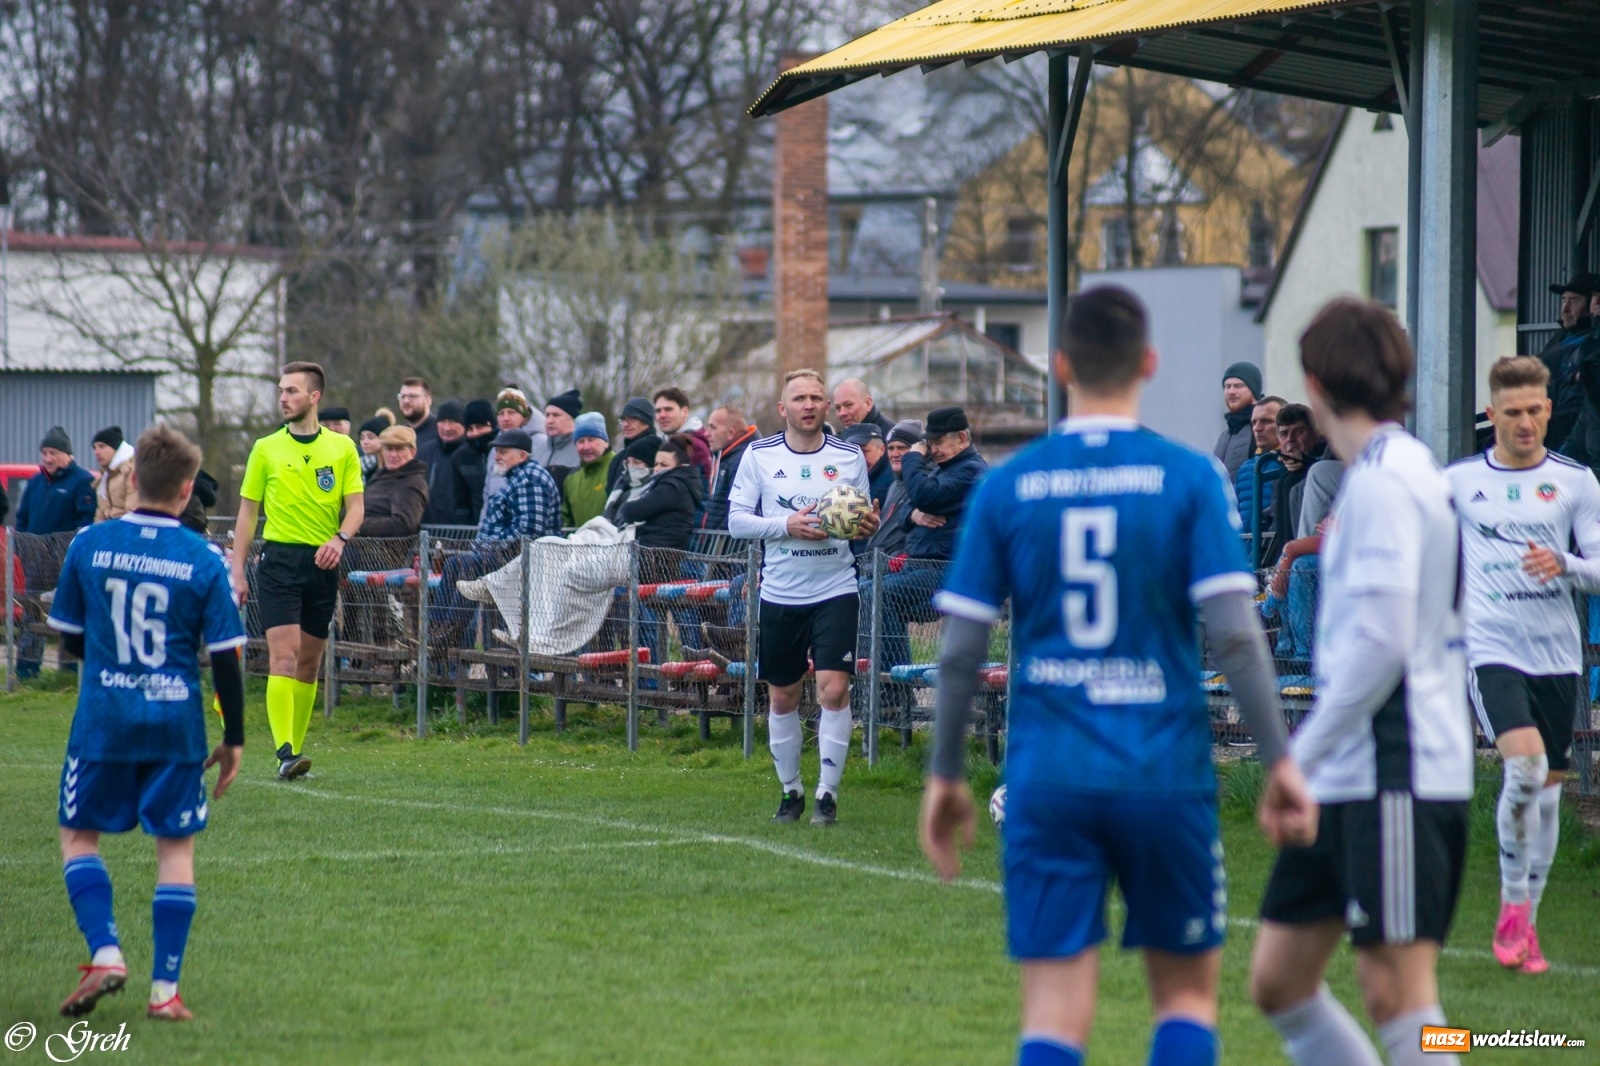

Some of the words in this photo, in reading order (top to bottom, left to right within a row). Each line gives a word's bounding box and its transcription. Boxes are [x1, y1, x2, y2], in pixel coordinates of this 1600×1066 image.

[92, 549, 113, 569] LKS
[791, 547, 838, 557] WENINGER
[1061, 506, 1118, 650] 5
[105, 577, 170, 669] 16
